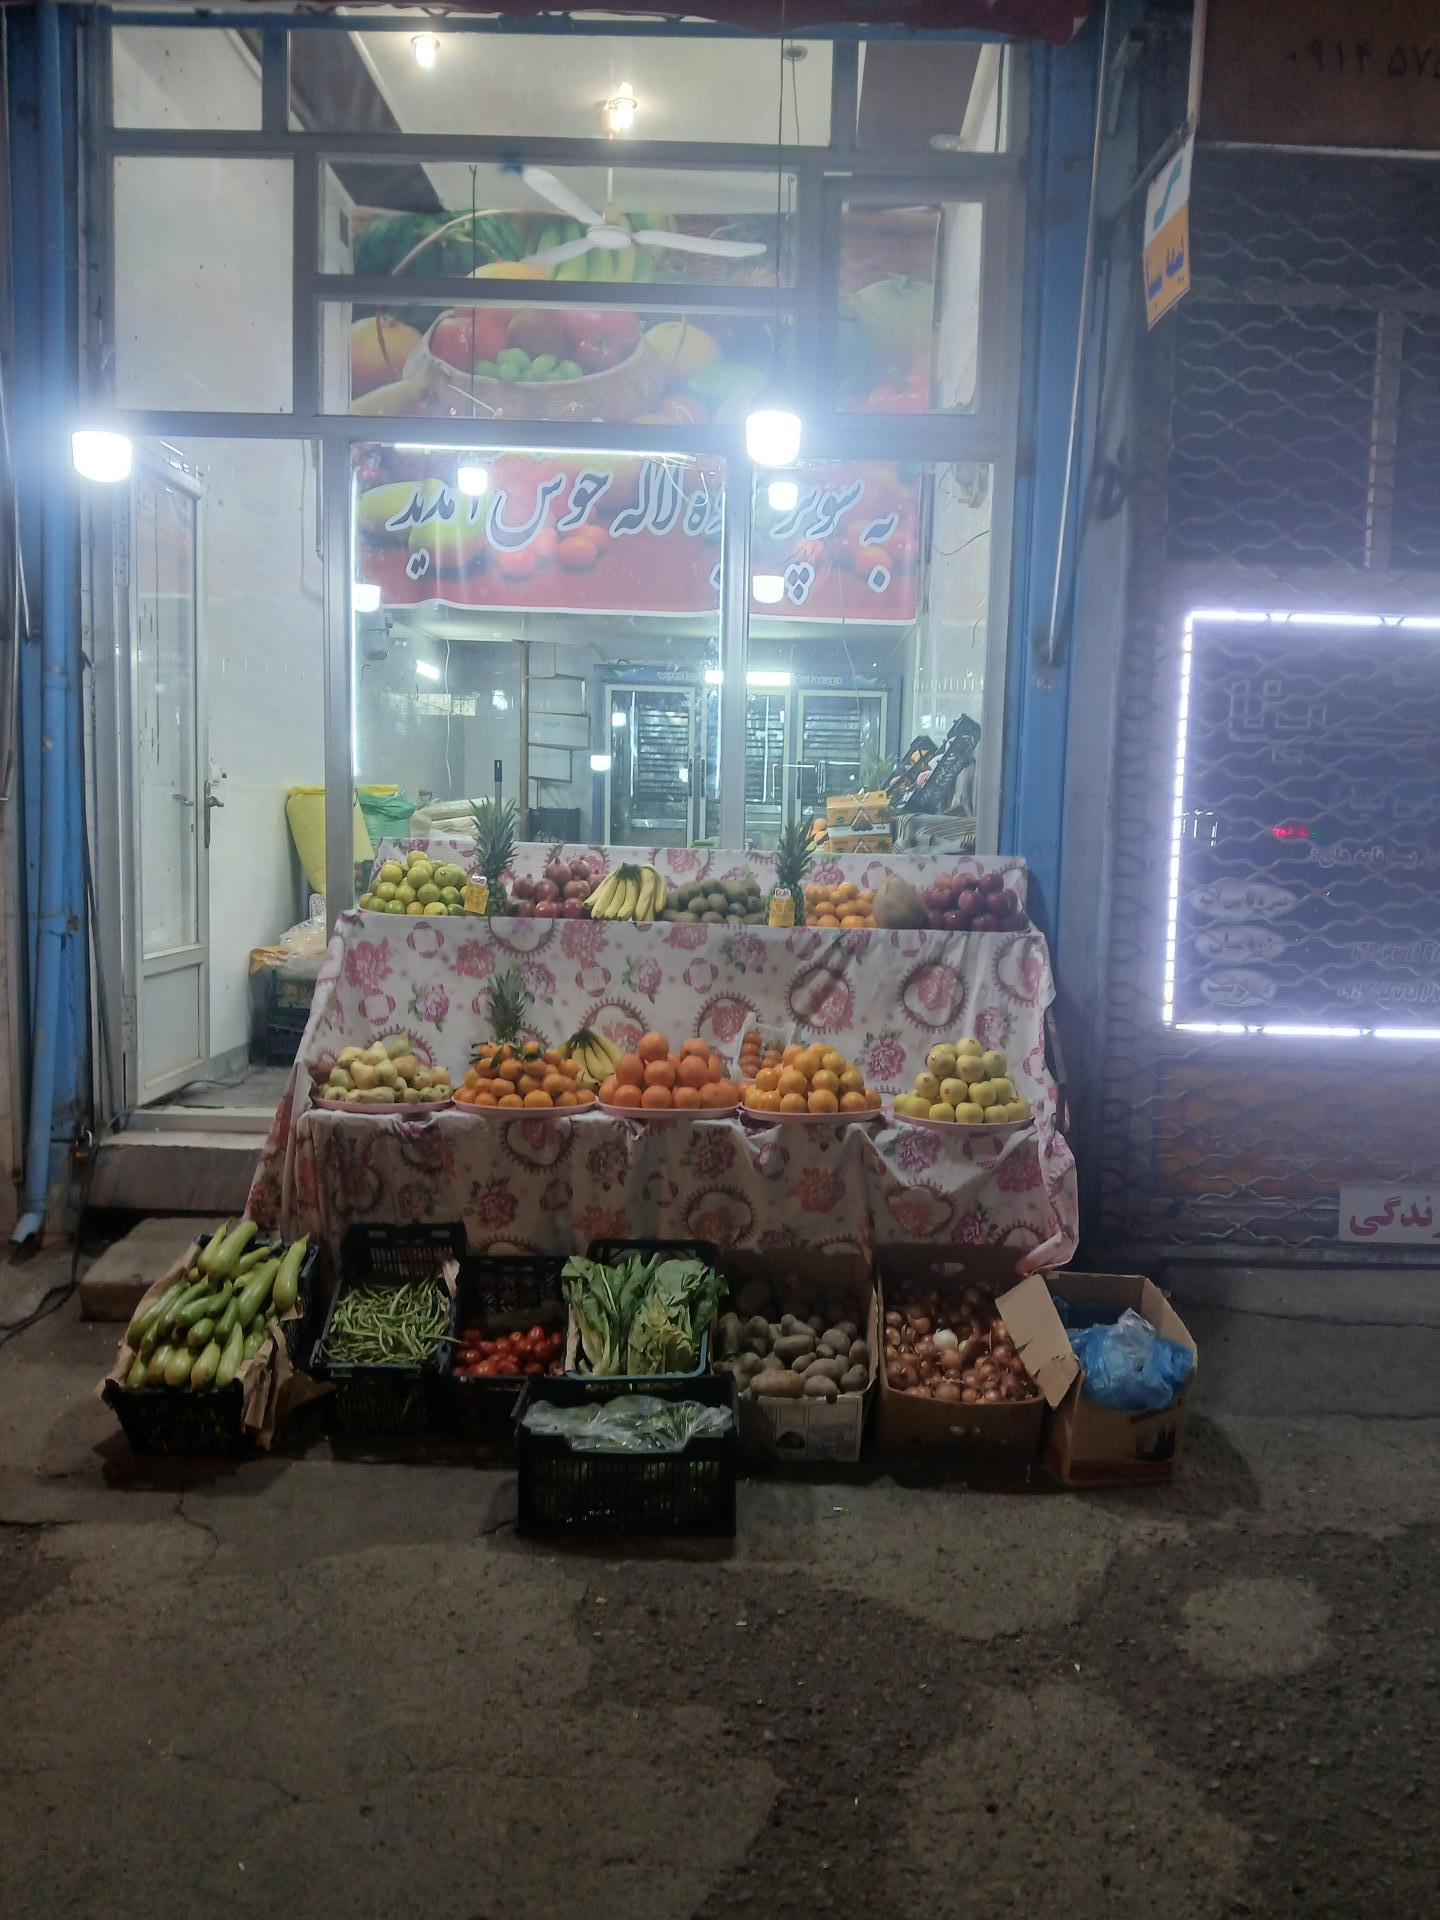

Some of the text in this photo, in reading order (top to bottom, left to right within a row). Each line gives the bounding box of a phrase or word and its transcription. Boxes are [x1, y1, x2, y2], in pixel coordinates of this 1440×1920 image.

[1288, 38, 1440, 78] ۰۹۱۴ ۵۷
[608, 460, 685, 538] لاله
[769, 477, 865, 605] سوپر
[858, 511, 899, 593] به
[1350, 1195, 1440, 1238] ندگی
